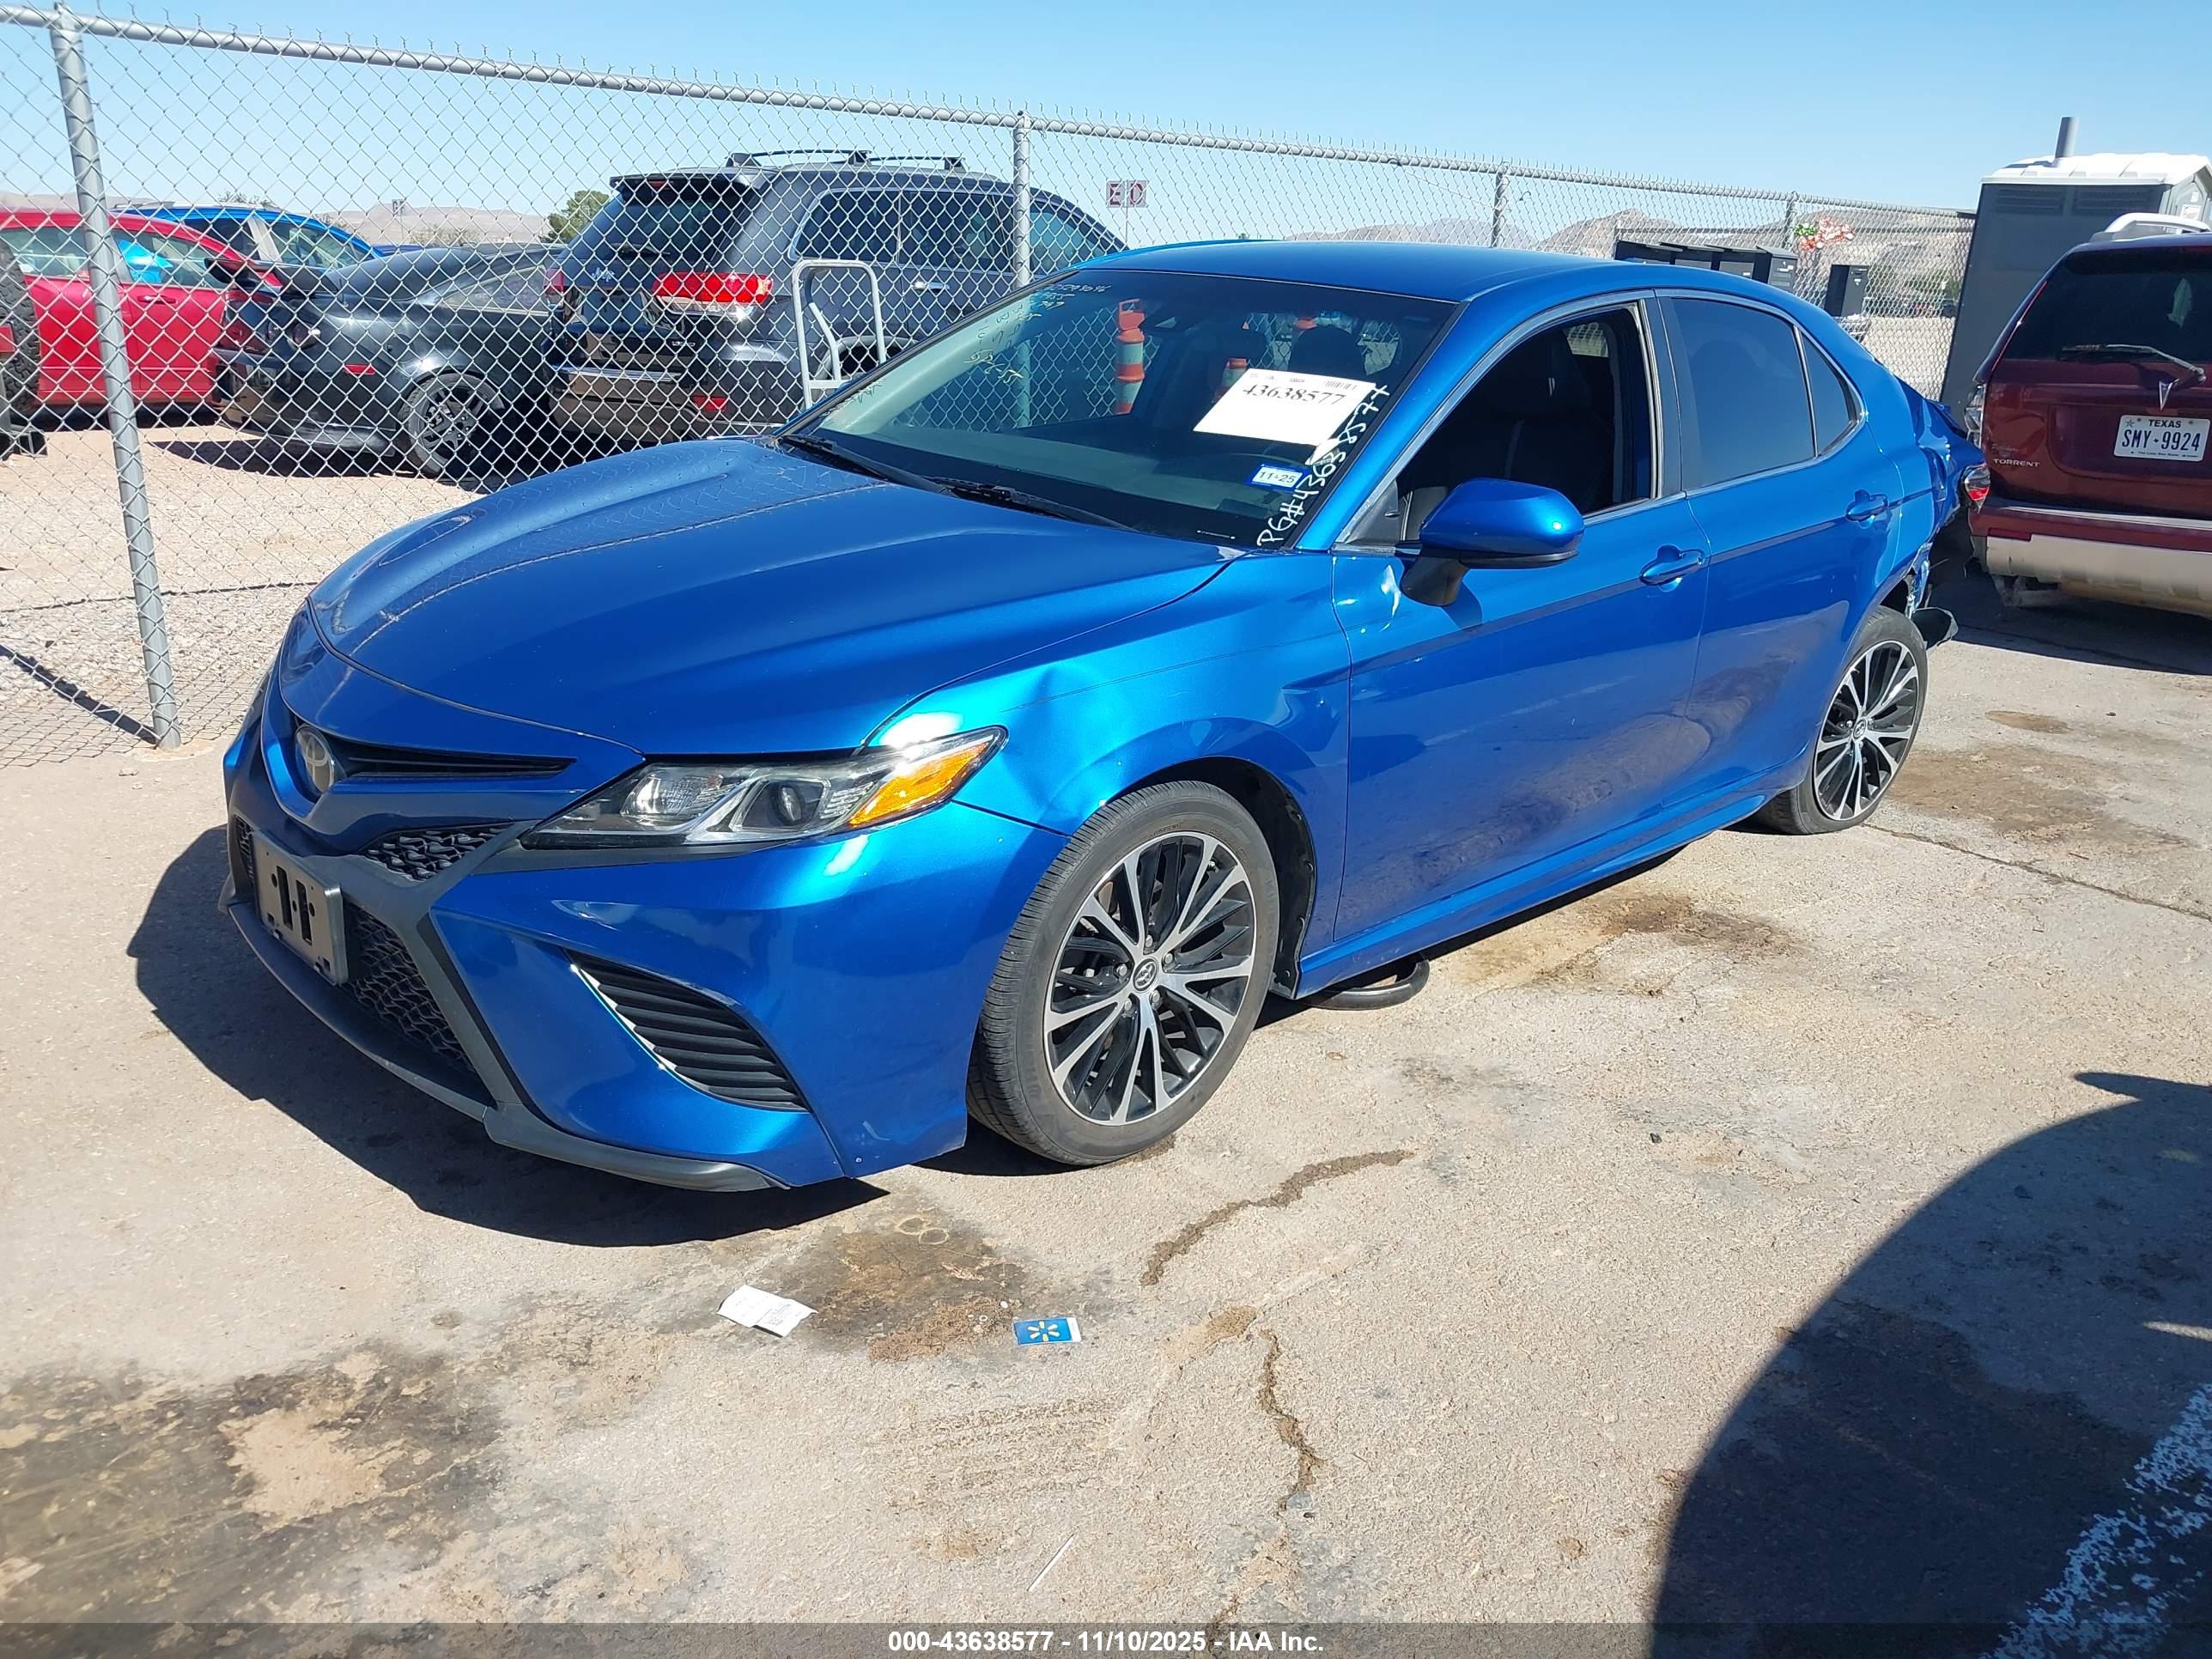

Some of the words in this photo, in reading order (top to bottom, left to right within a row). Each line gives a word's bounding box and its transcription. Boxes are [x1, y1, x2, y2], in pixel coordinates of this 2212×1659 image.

[1243, 383, 1346, 405] 43638577
[2148, 419, 2182, 428] TEXAS
[1993, 458, 2040, 467] TORRENT
